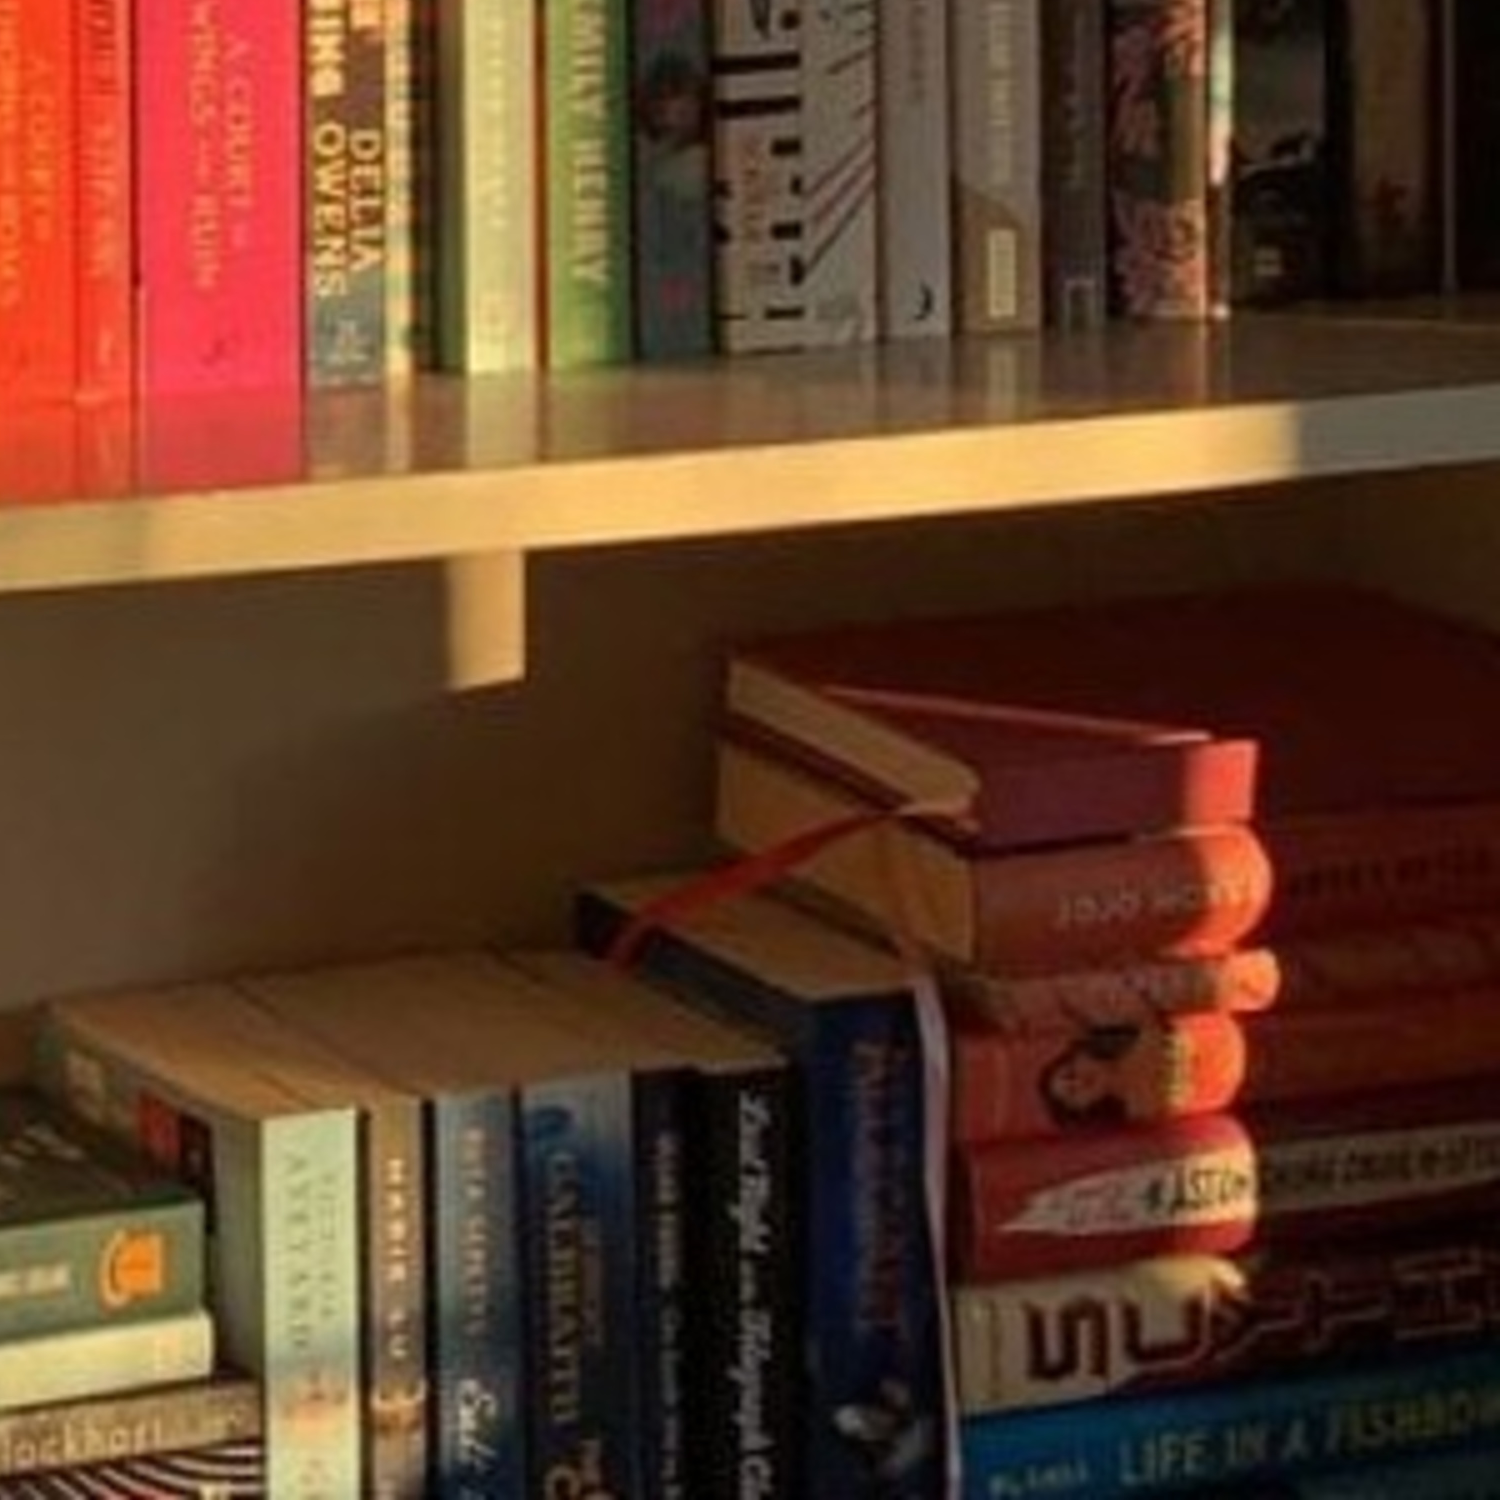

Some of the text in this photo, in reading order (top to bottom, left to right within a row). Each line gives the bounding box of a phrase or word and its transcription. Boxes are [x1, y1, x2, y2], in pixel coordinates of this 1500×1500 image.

[311, 118, 348, 300] OWENS
[348, 128, 385, 274] DELIA
[570, 137, 610, 289] HENRY
[1119, 1430, 1215, 1488] LIFE
